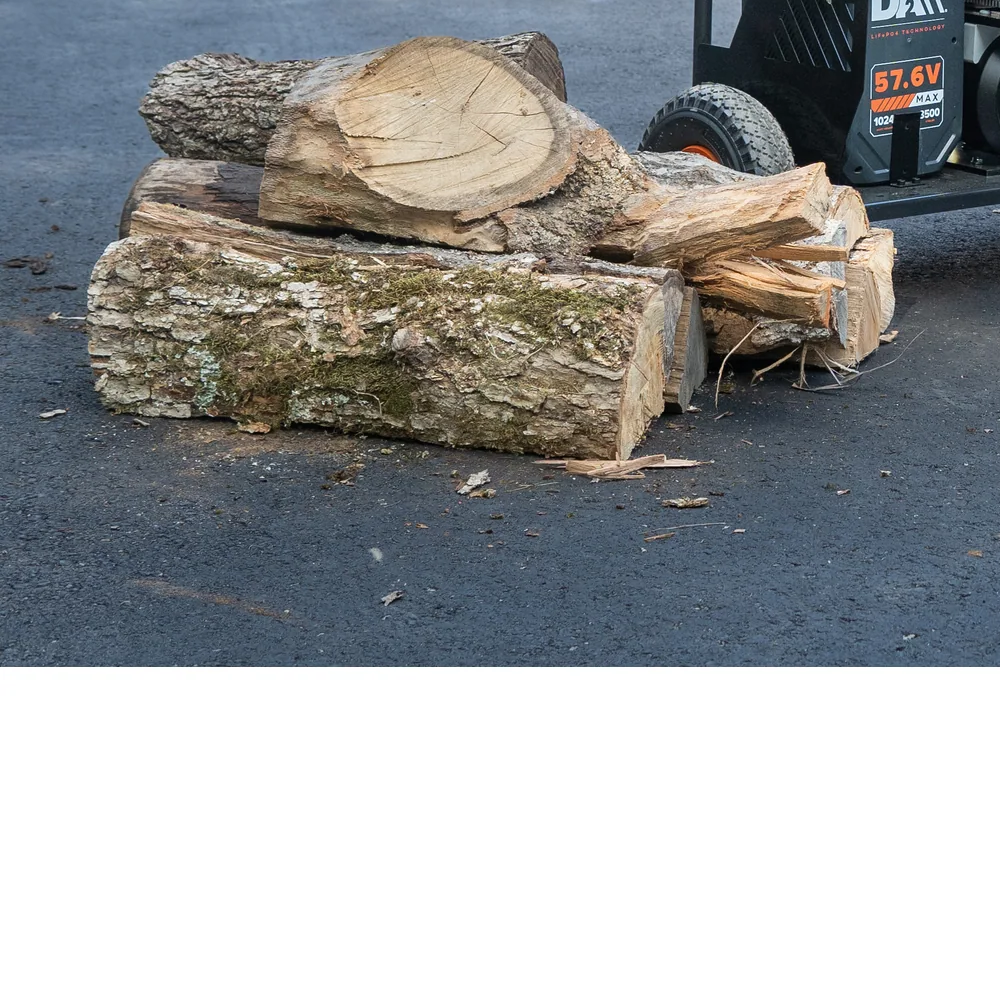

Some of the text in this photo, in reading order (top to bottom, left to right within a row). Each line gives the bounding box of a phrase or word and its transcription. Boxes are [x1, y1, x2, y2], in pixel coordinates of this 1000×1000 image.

[902, 24, 945, 34] TECHNOLOGY
[875, 62, 941, 93] 57.6V
[916, 93, 939, 103] MAX
[873, 114, 894, 126] 1024
